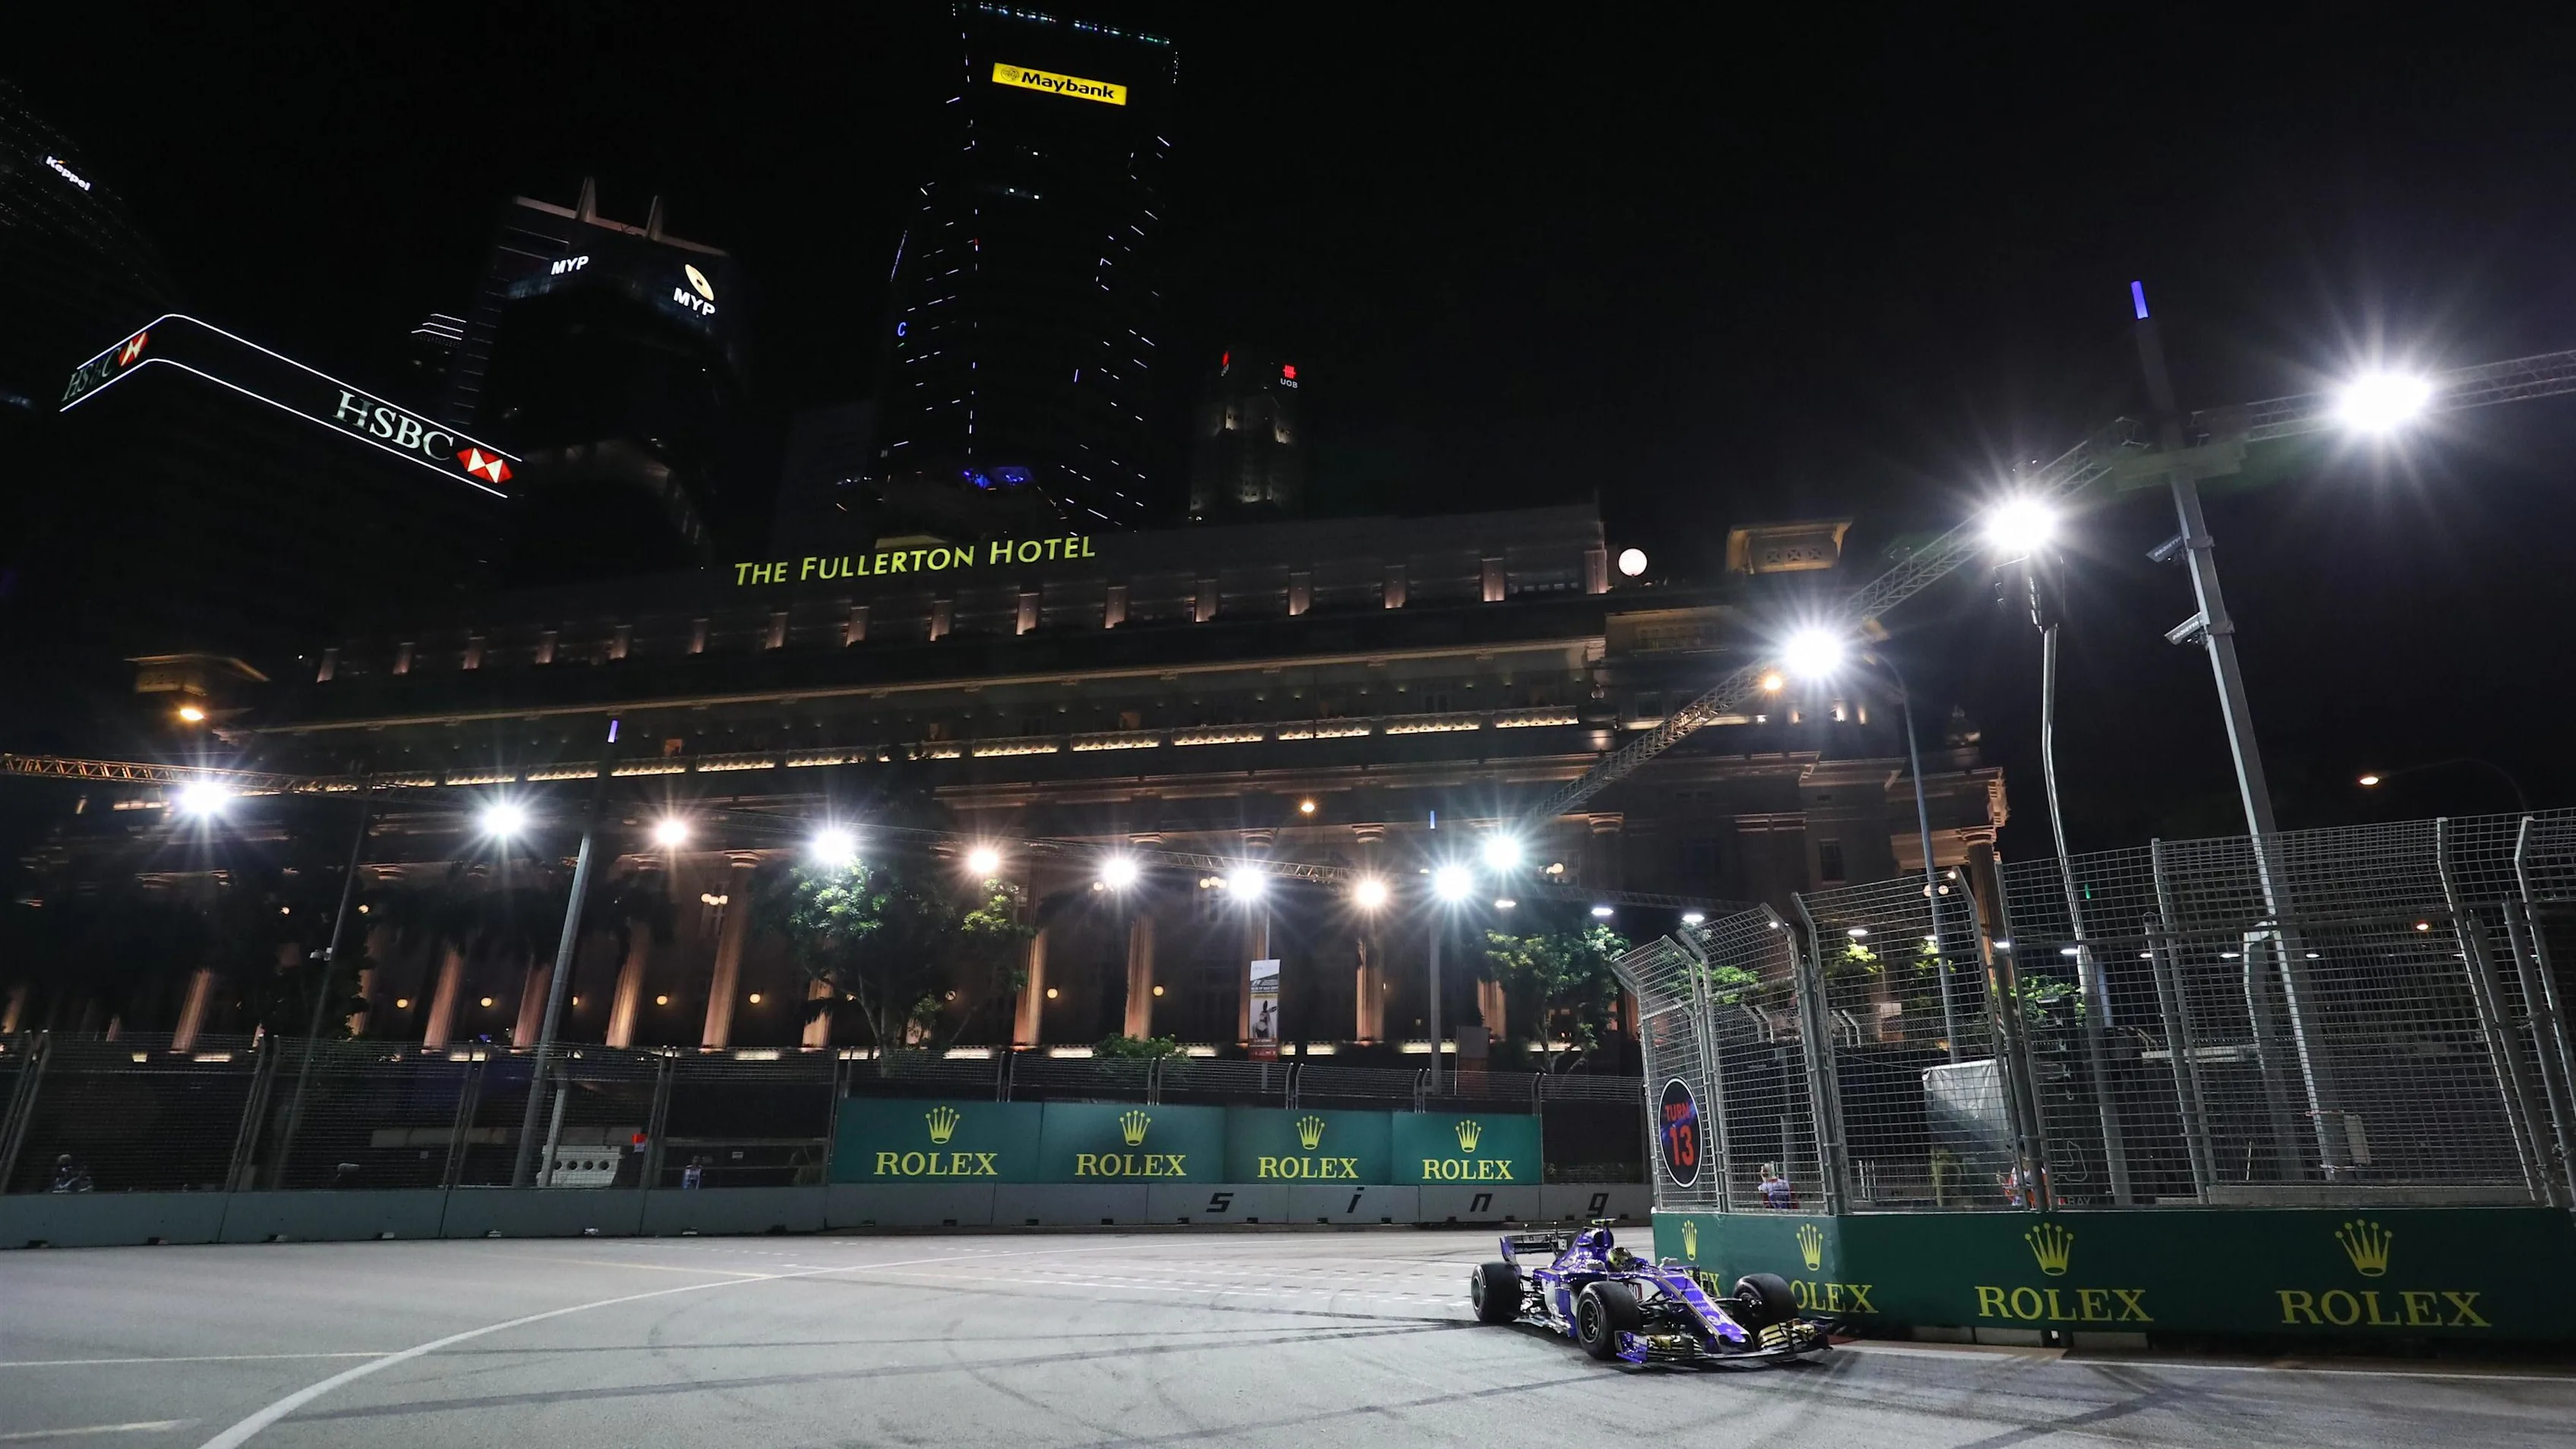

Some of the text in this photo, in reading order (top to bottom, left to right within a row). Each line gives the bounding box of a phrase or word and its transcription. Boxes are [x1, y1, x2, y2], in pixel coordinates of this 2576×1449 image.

[1021, 72, 1114, 99] Maybank
[46, 156, 90, 191] Keppel
[551, 256, 589, 275] MYP
[674, 287, 715, 316] MYP
[1280, 377, 1298, 388] UOB
[332, 390, 453, 461] HSBC
[734, 536, 1096, 586] THE FULLERTON HOTEL
[1665, 1102, 1691, 1121] TURN
[1669, 1124, 1694, 1166] 13
[873, 1151, 998, 1176] ROLEX
[1075, 1154, 1187, 1176] ROLEX
[1258, 1157, 1359, 1179] ROLEX
[1422, 1159, 1514, 1180] ROLEX
[1790, 1280, 1879, 1313] OLEX
[1975, 1286, 2154, 1322] ROLEX
[2276, 1290, 2492, 1327] ROLEX
